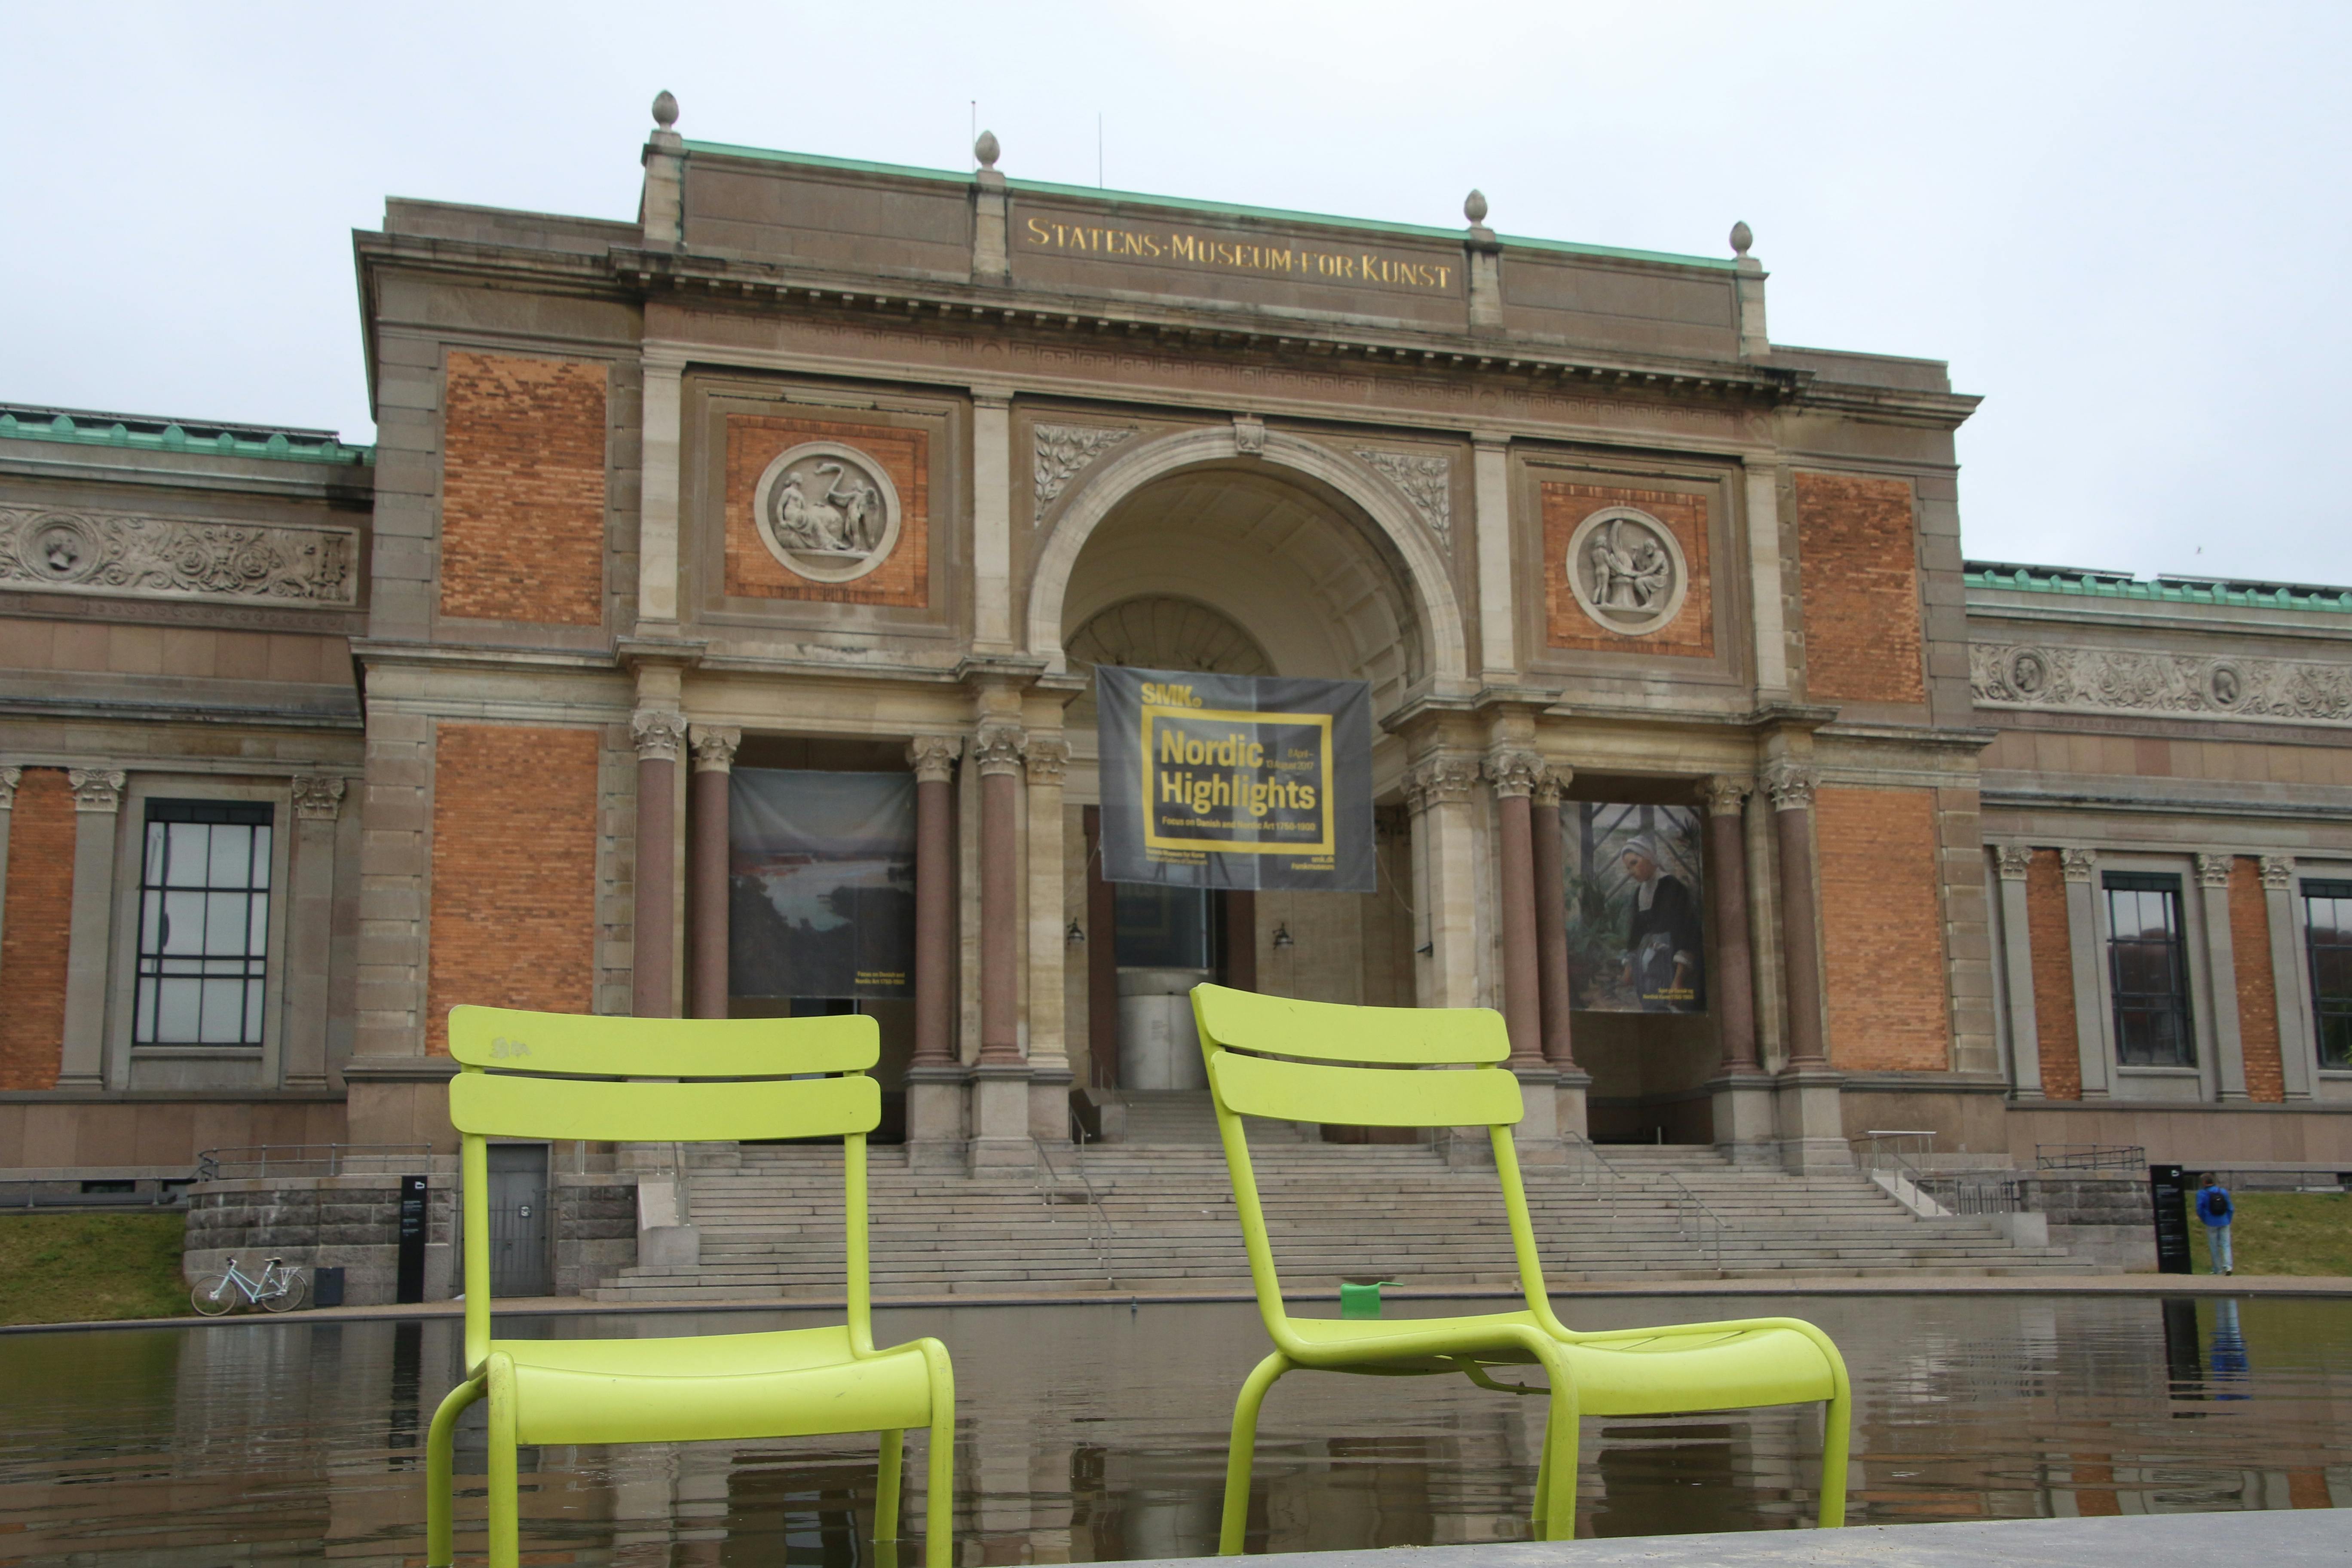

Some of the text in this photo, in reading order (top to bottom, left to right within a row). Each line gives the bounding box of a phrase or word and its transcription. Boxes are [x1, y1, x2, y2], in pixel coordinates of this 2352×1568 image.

[1161, 729, 1264, 768] Nordic
[1161, 771, 1316, 816] Highlights
[1162, 816, 1184, 826] Focus
[1196, 818, 1221, 828] Danish
[1222, 820, 1237, 829] and
[1263, 821, 1275, 830] Art
